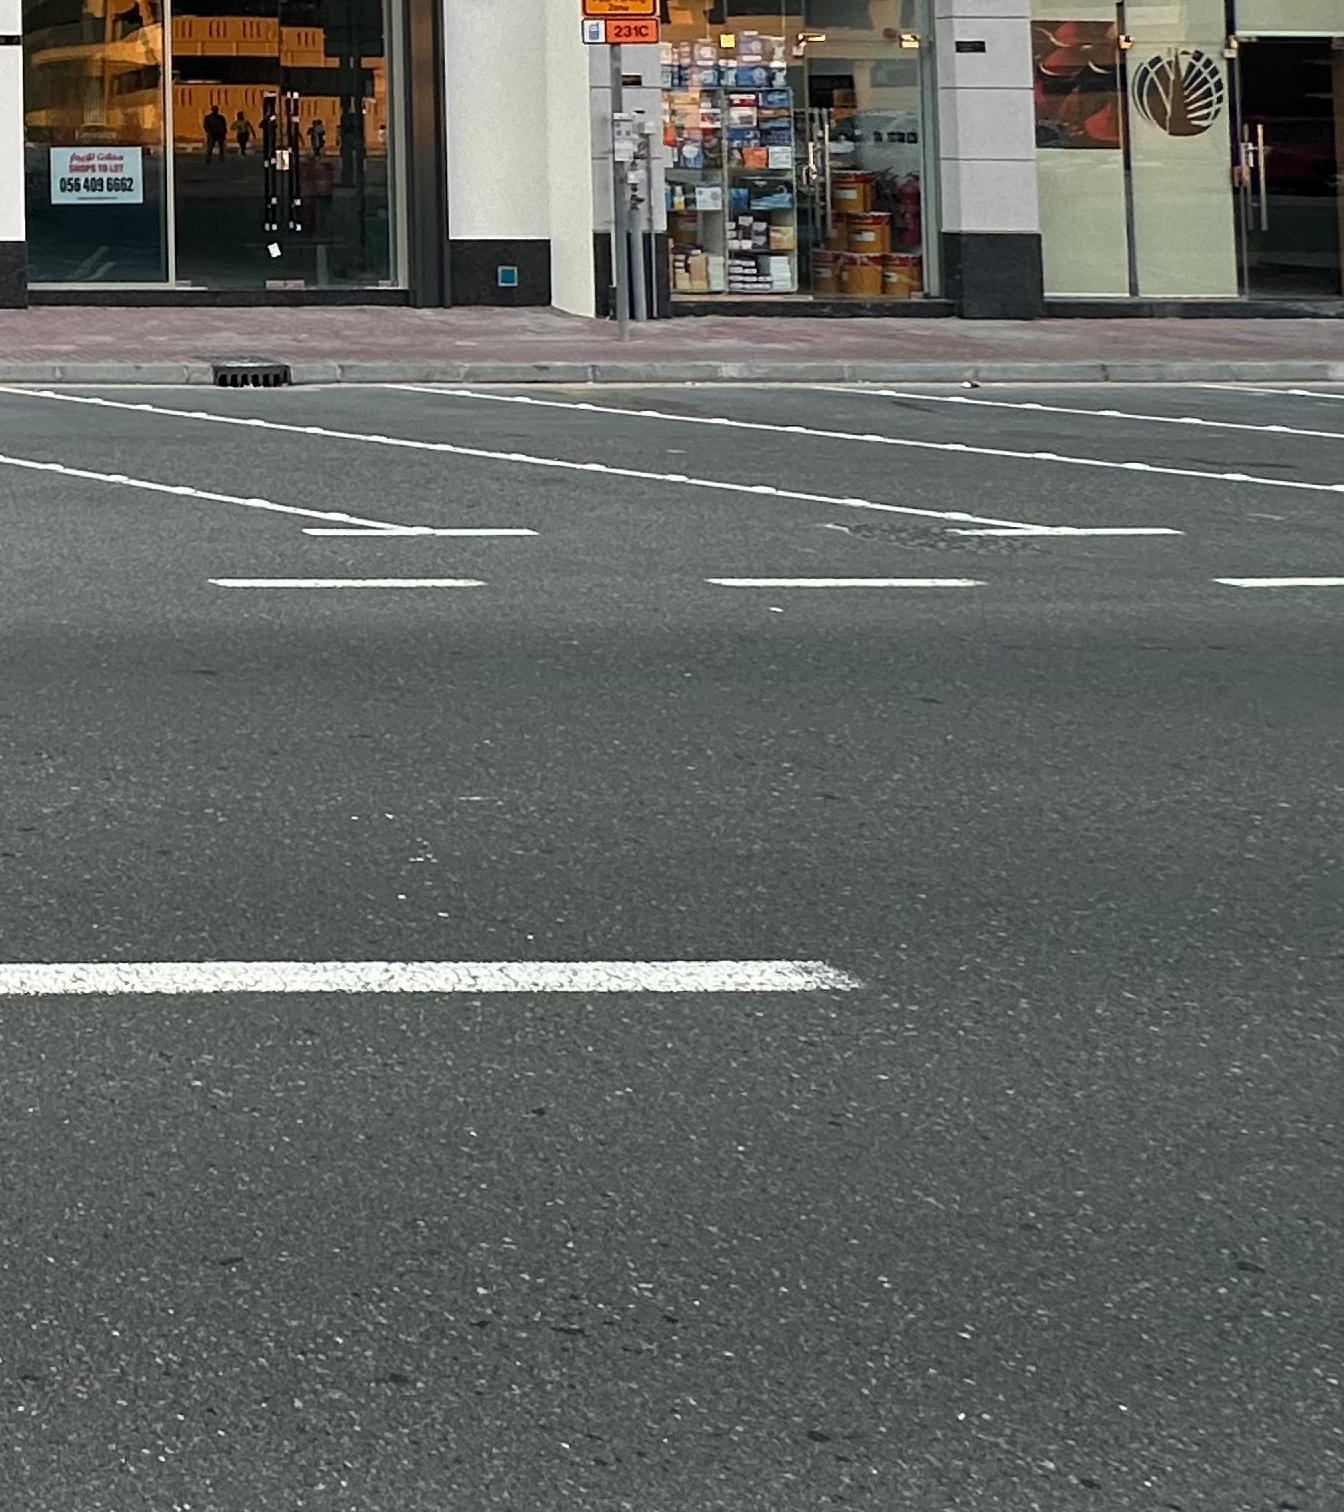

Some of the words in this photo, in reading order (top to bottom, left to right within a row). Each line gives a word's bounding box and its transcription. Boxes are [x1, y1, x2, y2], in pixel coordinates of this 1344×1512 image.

[613, 24, 650, 38] 231C
[97, 164, 108, 174] TO
[109, 164, 124, 174] LET
[59, 177, 81, 193] 056
[82, 177, 105, 193] 409
